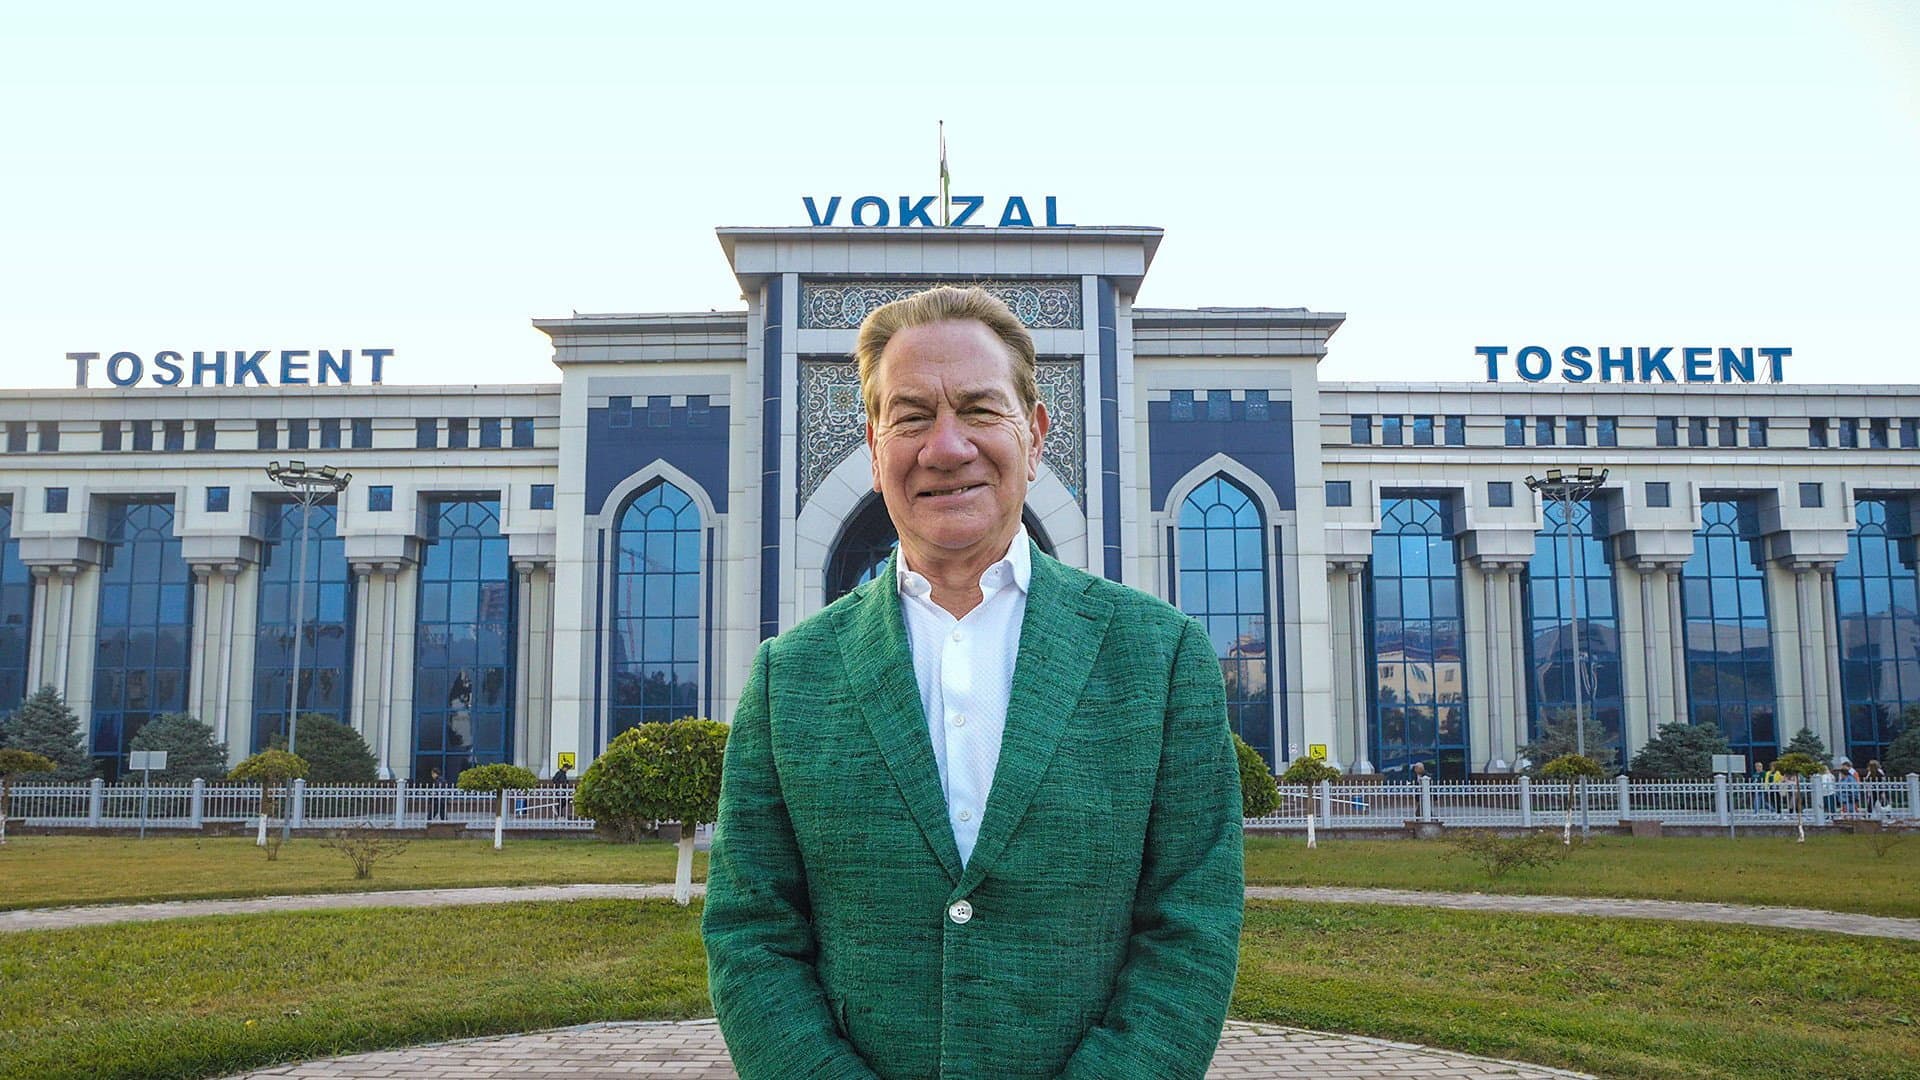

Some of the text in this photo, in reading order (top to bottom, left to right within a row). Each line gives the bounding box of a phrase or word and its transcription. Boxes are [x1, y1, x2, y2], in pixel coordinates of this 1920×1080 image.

[802, 196, 1076, 227] VOKZAL
[66, 349, 394, 387] TOSHKENT
[1475, 346, 1792, 382] TOSHKENT
